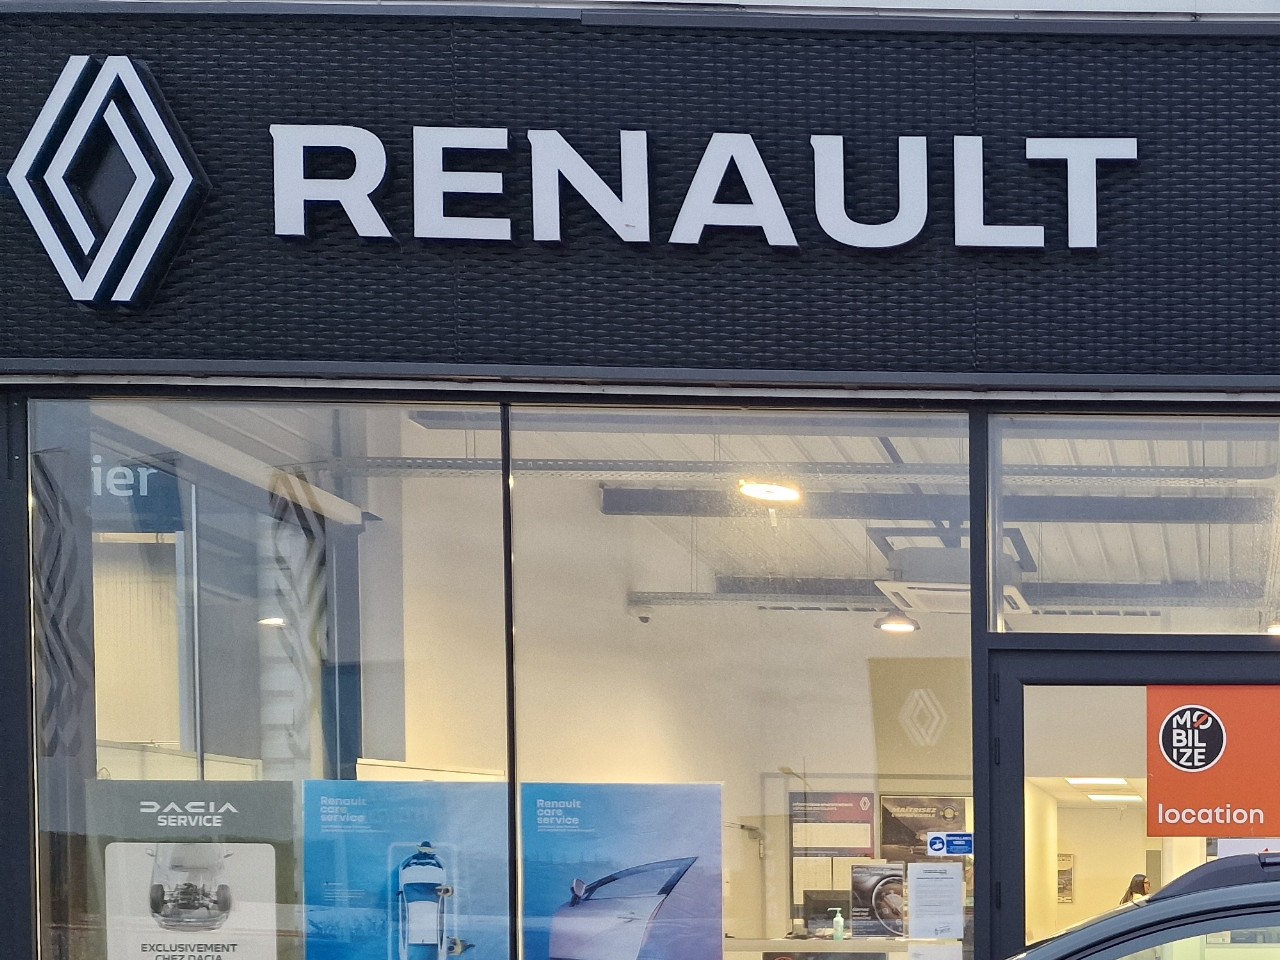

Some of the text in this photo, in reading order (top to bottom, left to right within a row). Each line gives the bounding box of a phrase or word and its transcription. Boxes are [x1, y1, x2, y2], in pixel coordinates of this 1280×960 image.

[269, 124, 1138, 249] RENAULT
[320, 796, 368, 806] Renault
[536, 799, 581, 809] Renault
[139, 801, 239, 813] DACIA
[536, 808, 563, 816] care
[320, 813, 366, 822] service
[1157, 803, 1265, 825] location
[157, 814, 223, 828] SERVICE
[536, 816, 580, 824] service
[140, 943, 238, 953] EXCLUSIVEMENT
